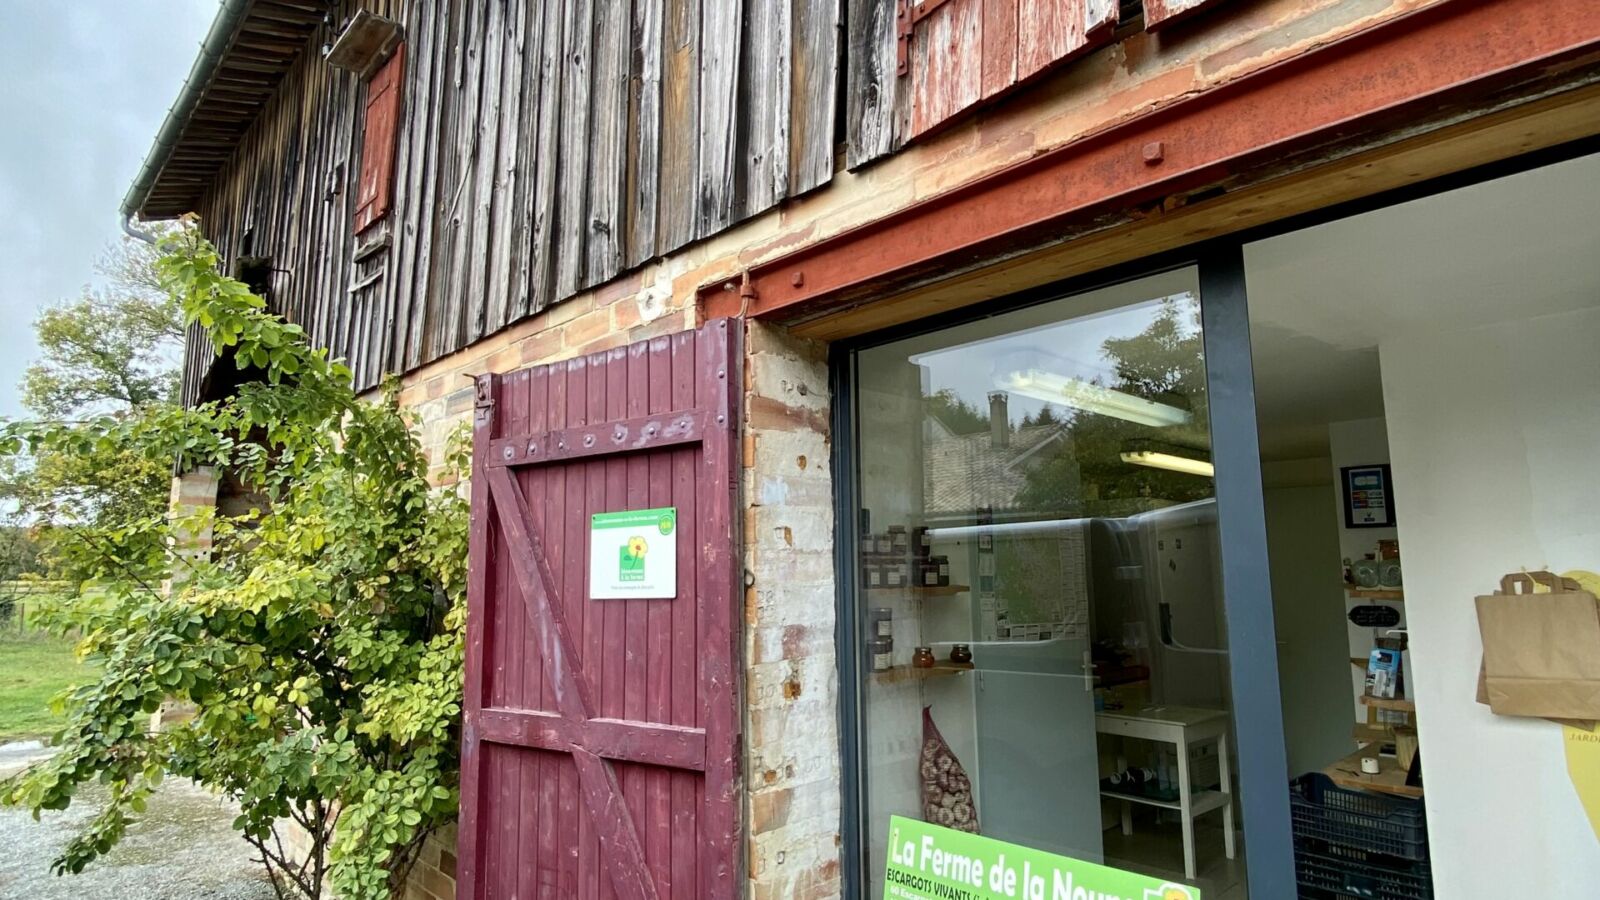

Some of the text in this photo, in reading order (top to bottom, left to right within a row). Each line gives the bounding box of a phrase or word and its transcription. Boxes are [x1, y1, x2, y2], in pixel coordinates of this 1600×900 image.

[887, 868, 932, 893] ESCARGOTS
[892, 828, 916, 868] La
[920, 835, 984, 888] Ferme
[989, 854, 1017, 897] de
[1023, 861, 1046, 900] la
